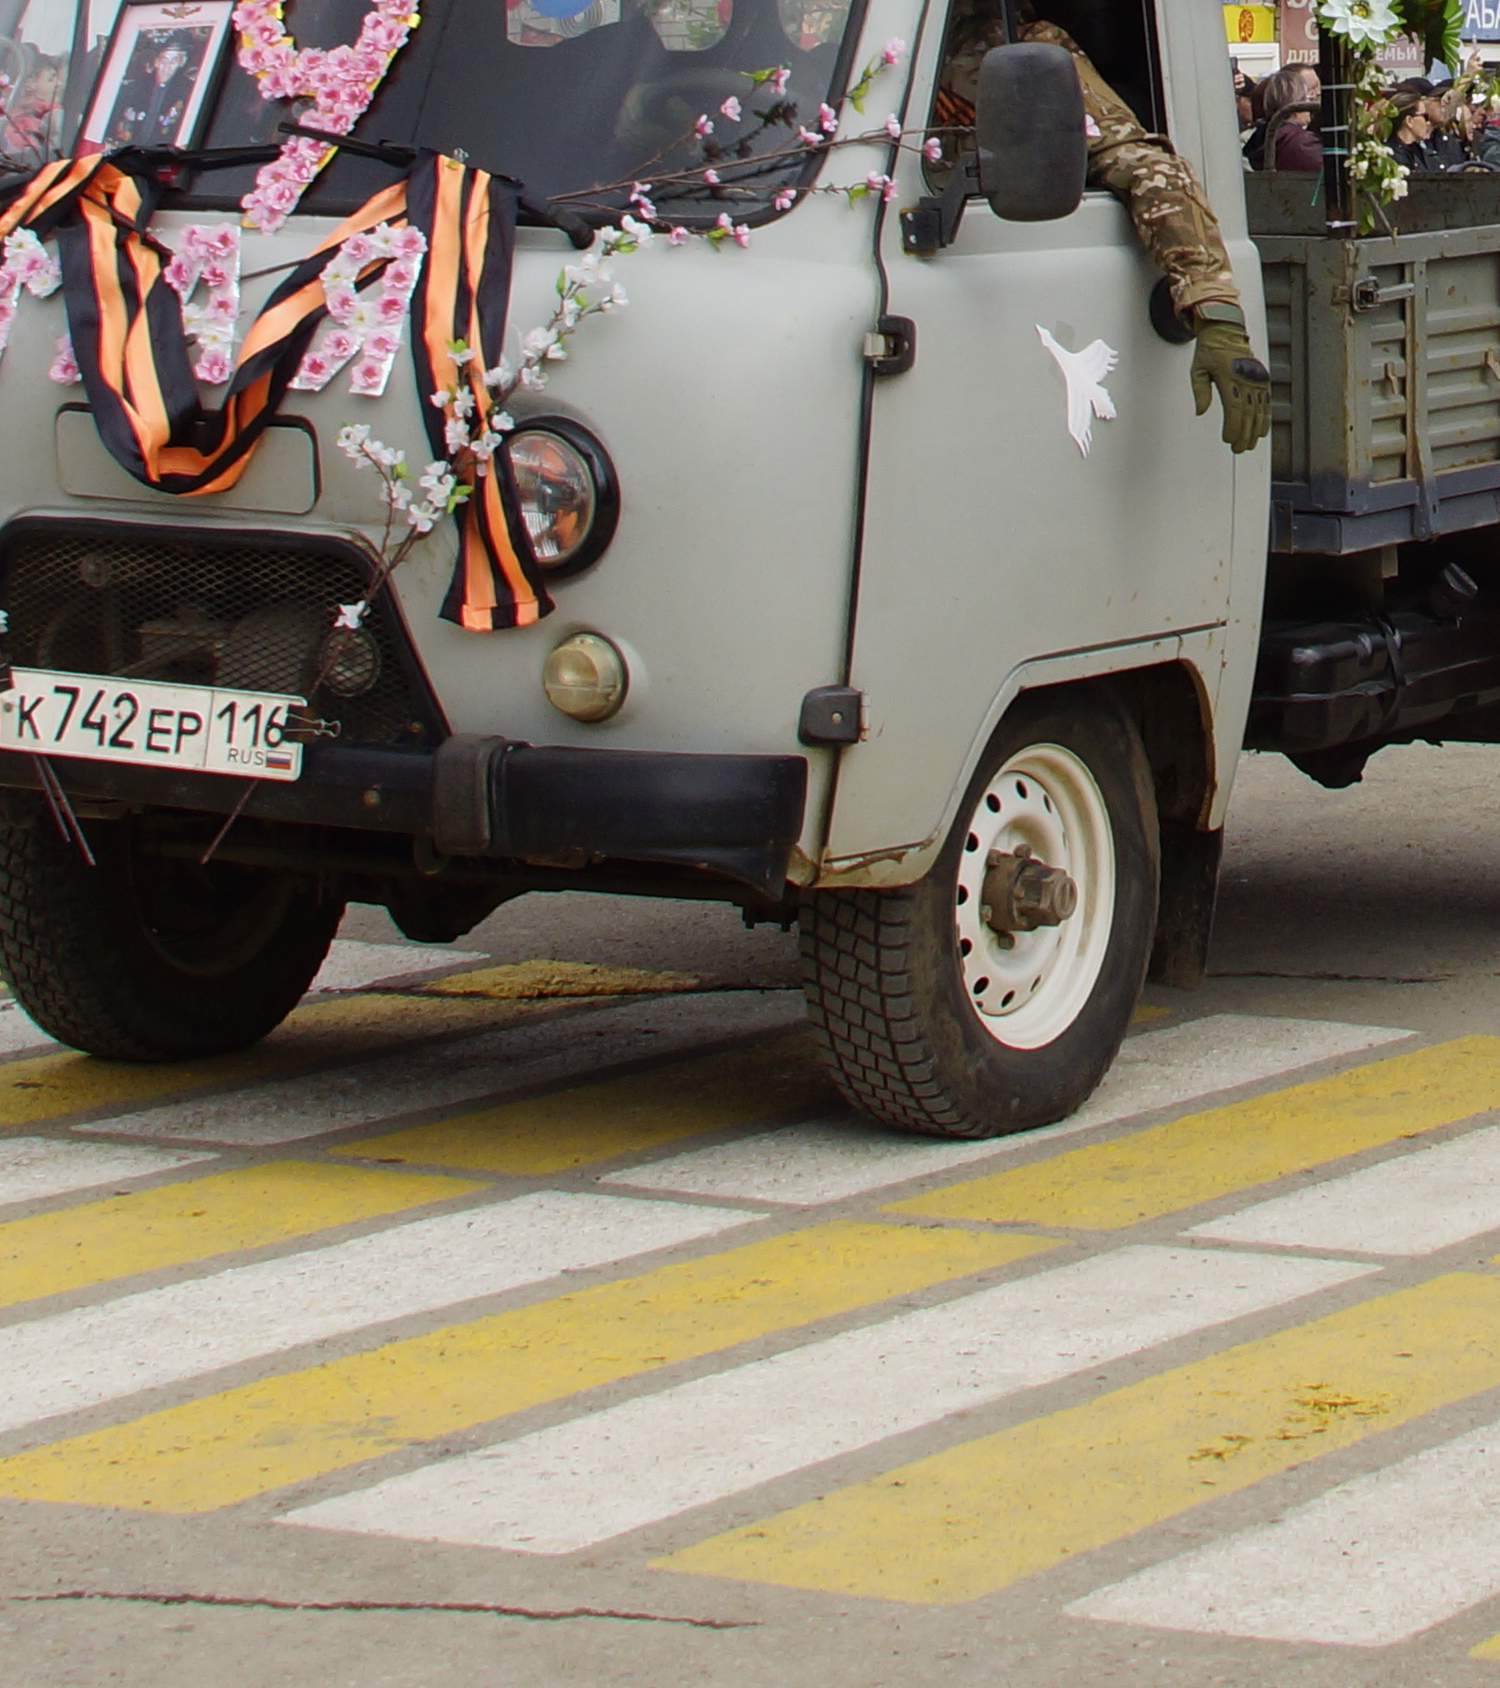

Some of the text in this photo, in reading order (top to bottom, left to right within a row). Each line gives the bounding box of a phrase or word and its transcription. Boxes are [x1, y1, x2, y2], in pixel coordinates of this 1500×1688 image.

[1375, 46, 1417, 62] ЕМЬИ
[216, 699, 286, 748] 116
[227, 746, 265, 766] RUS
